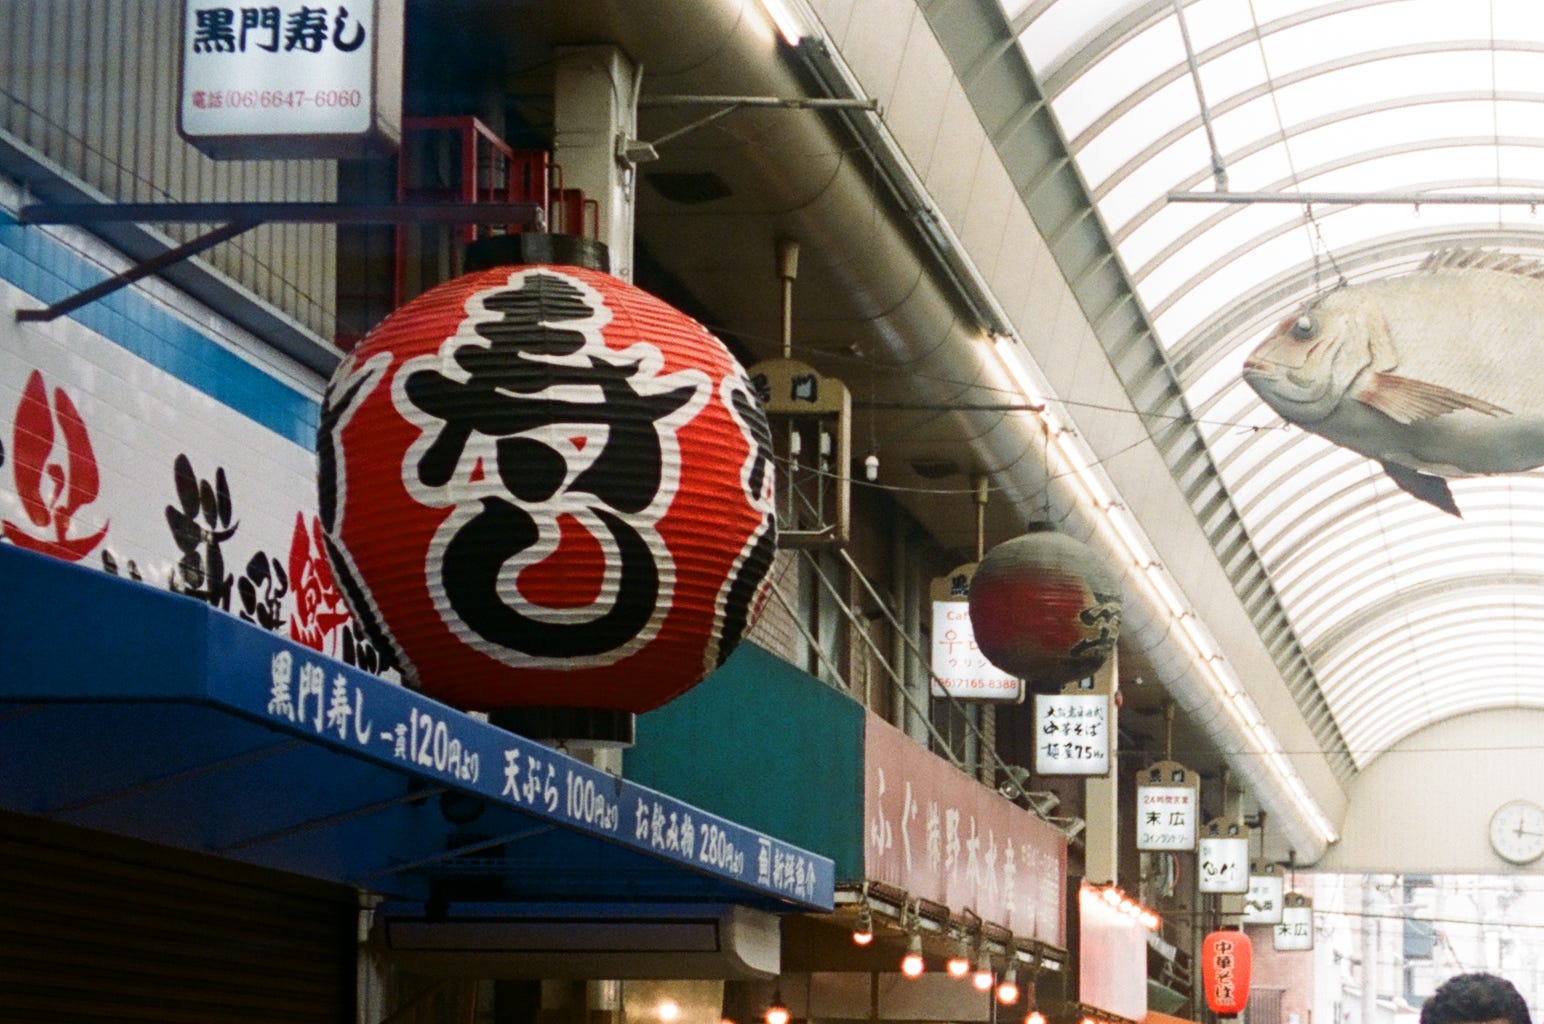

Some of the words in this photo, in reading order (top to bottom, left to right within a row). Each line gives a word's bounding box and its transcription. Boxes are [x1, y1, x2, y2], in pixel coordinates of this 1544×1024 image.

[193, 6, 366, 53] 黒門寿し
[191, 89, 361, 109] 電話(06)6647-6060
[268, 650, 372, 745] 黒門寿し
[1042, 720, 1102, 737] 中華そば
[1145, 811, 1186, 826] 末広
[1215, 941, 1236, 999] 中華そば
